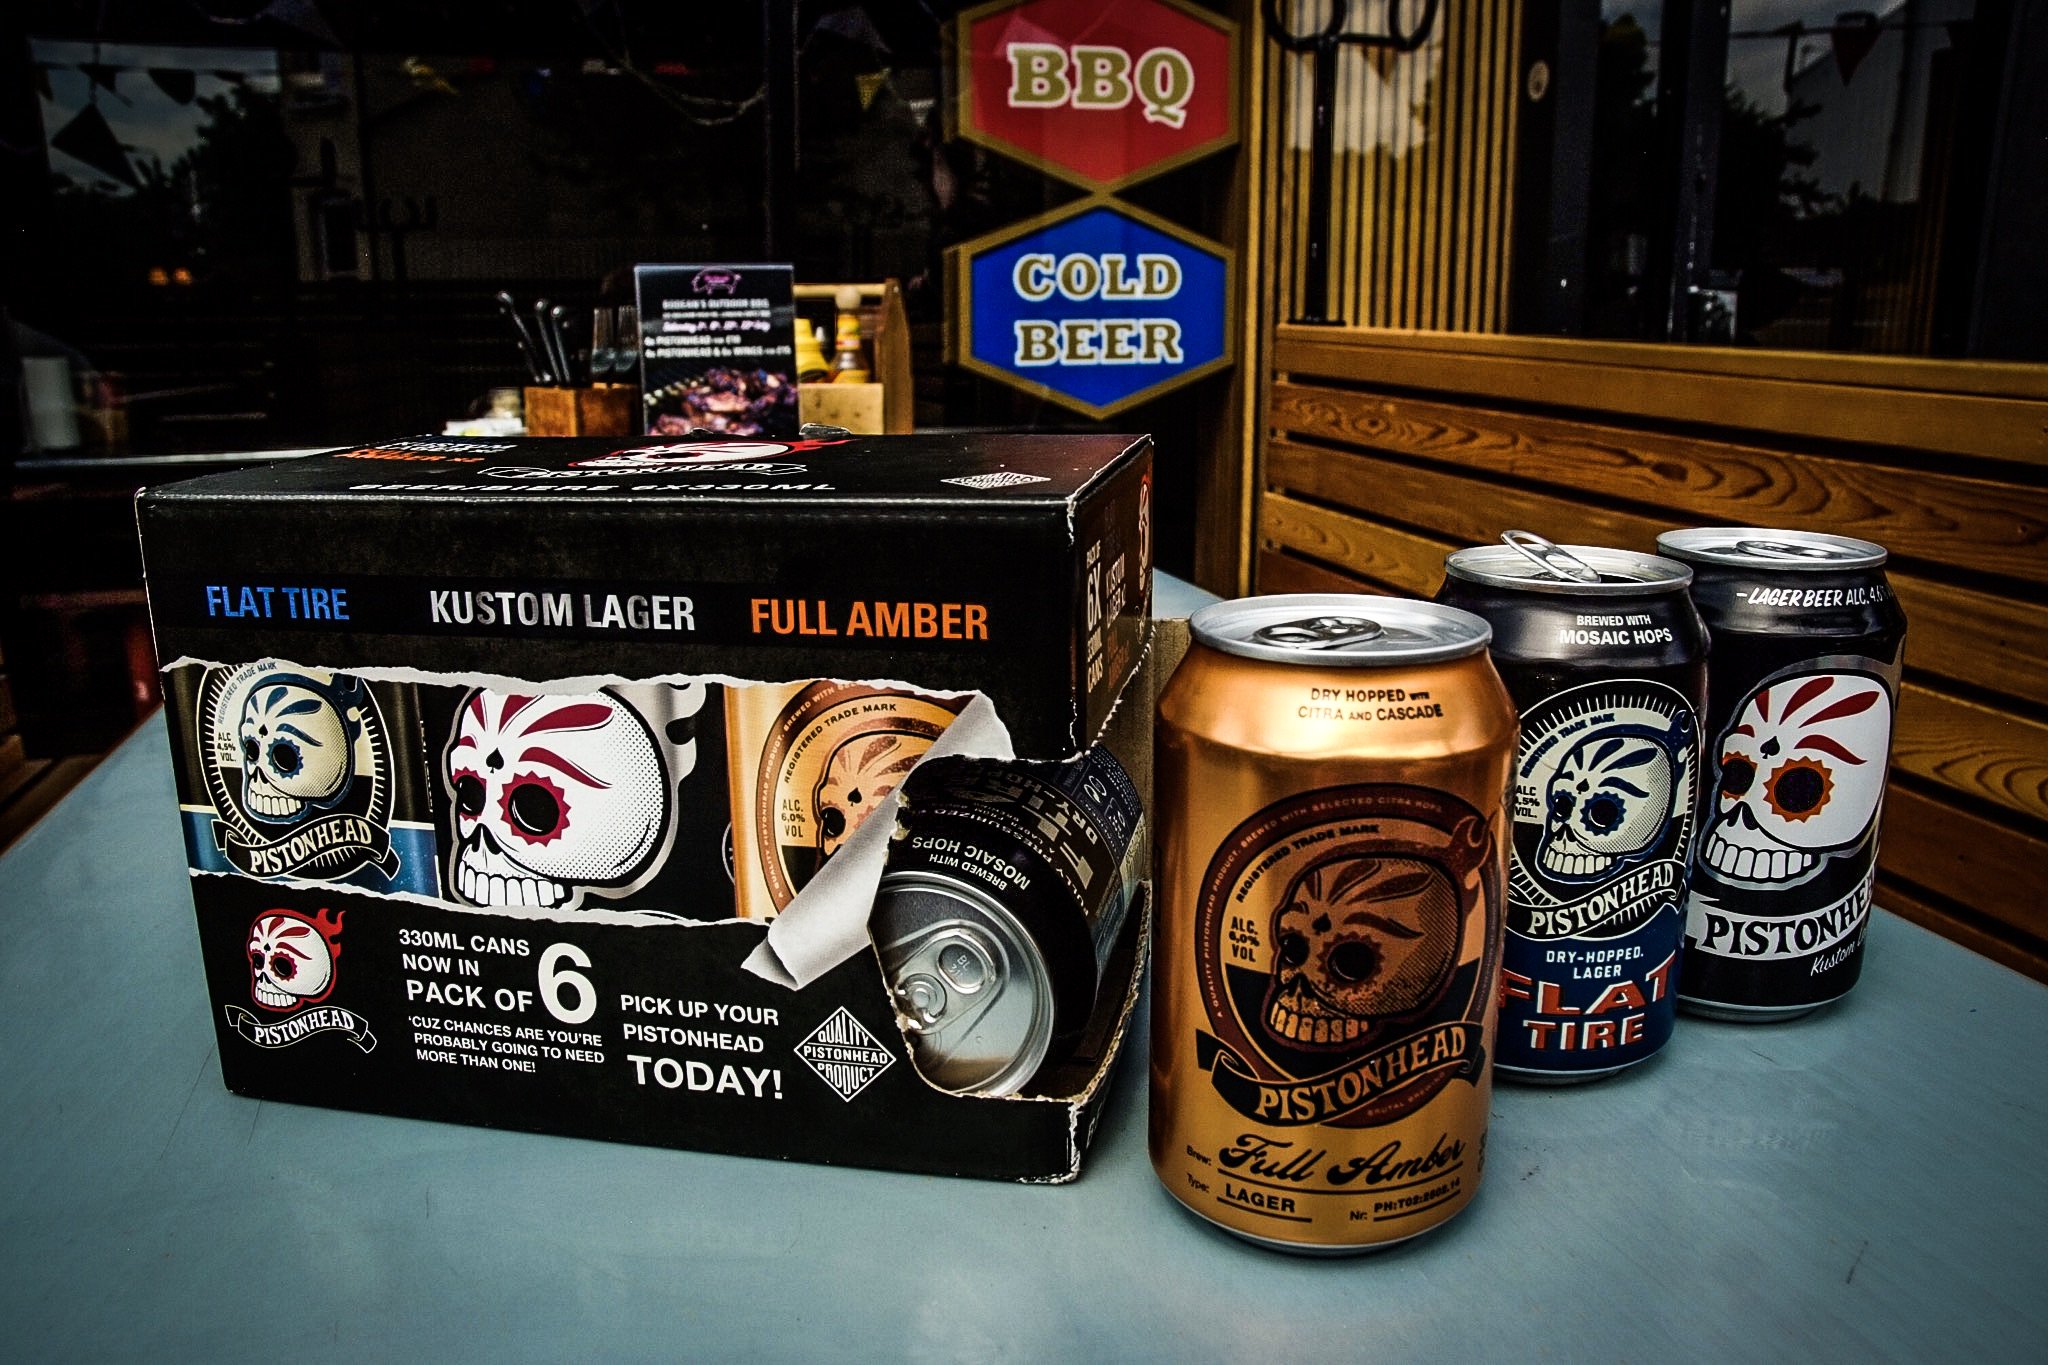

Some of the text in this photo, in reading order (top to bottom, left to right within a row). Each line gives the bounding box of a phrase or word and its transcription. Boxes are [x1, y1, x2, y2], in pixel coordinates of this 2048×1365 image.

[1007, 43, 1194, 128] BBQ
[1013, 253, 1182, 301] COLD
[1014, 319, 1183, 366] BEER
[523, 463, 772, 478] PISTONHEAD
[205, 585, 350, 621] FLAT TIRE
[430, 590, 696, 631] KUSTOM LAGER
[1803, 589, 1842, 608] BEER
[1845, 587, 1870, 606] ALC.
[751, 598, 989, 640] FULL AMBER
[1576, 614, 1652, 626] BREWED WITH
[1559, 627, 1673, 645] MOSAIC HOPS
[236, 668, 257, 684] TRADE
[1311, 688, 1340, 702] DRY
[1346, 688, 1406, 702] HOPPED
[1298, 703, 1444, 721] CITRA AND CASCADE
[217, 733, 232, 742] ALC
[784, 703, 897, 783] REGISTERED TRADE MARK
[761, 782, 769, 846] PISTONHEAD
[783, 702, 811, 731] BREWED
[812, 686, 835, 703] WITH
[782, 799, 804, 813] ALC.
[1516, 785, 1536, 796] ALC
[250, 817, 373, 874] PISTONHEAD
[784, 824, 804, 838] VOL
[911, 835, 961, 853] HOPS
[928, 853, 1007, 891] BREWED WITH
[964, 844, 1031, 890] MOSAIC
[1236, 824, 1380, 903] REGISTERED TRADE MARK
[1203, 894, 1216, 959] PISTONHEAD
[1240, 819, 1277, 848] BREWED
[1280, 808, 1307, 822] WITH
[1526, 862, 1674, 935] PISTONHEAD
[1231, 916, 1258, 935] ALC.
[1702, 877, 1873, 956] PISTONHE
[399, 928, 530, 957] 330ML CANS
[1232, 944, 1256, 962] VOL
[1810, 941, 1856, 977] Kustom
[402, 953, 479, 976] NOW IN
[1573, 964, 1622, 980] LAGER
[406, 942, 597, 1024] PACK OF 6
[1499, 949, 1676, 1015] FLAT
[620, 994, 779, 1026] PICK UP YOUR
[254, 1009, 355, 1046] PISTONHEAD
[444, 1018, 512, 1038] CHANCES
[515, 1024, 544, 1040] ARE
[547, 1029, 602, 1047] YOU'RE
[623, 1023, 764, 1053] PISTONHEAD
[817, 1011, 870, 1047] QUALITY
[1523, 1012, 1645, 1050] TIRE
[414, 1033, 605, 1064] PROBABLY GOING TO NEED
[416, 1049, 536, 1073] MORE THAN ONE!
[804, 1045, 888, 1064] PISTONHEAD
[627, 1054, 783, 1100] TODAY!
[817, 1062, 875, 1095] PRODUCT
[1254, 1026, 1467, 1121] PISTONHEAD
[1218, 1133, 1327, 1182] Full
[1326, 1132, 1467, 1186] Amber
[1225, 1183, 1295, 1213] LAGER
